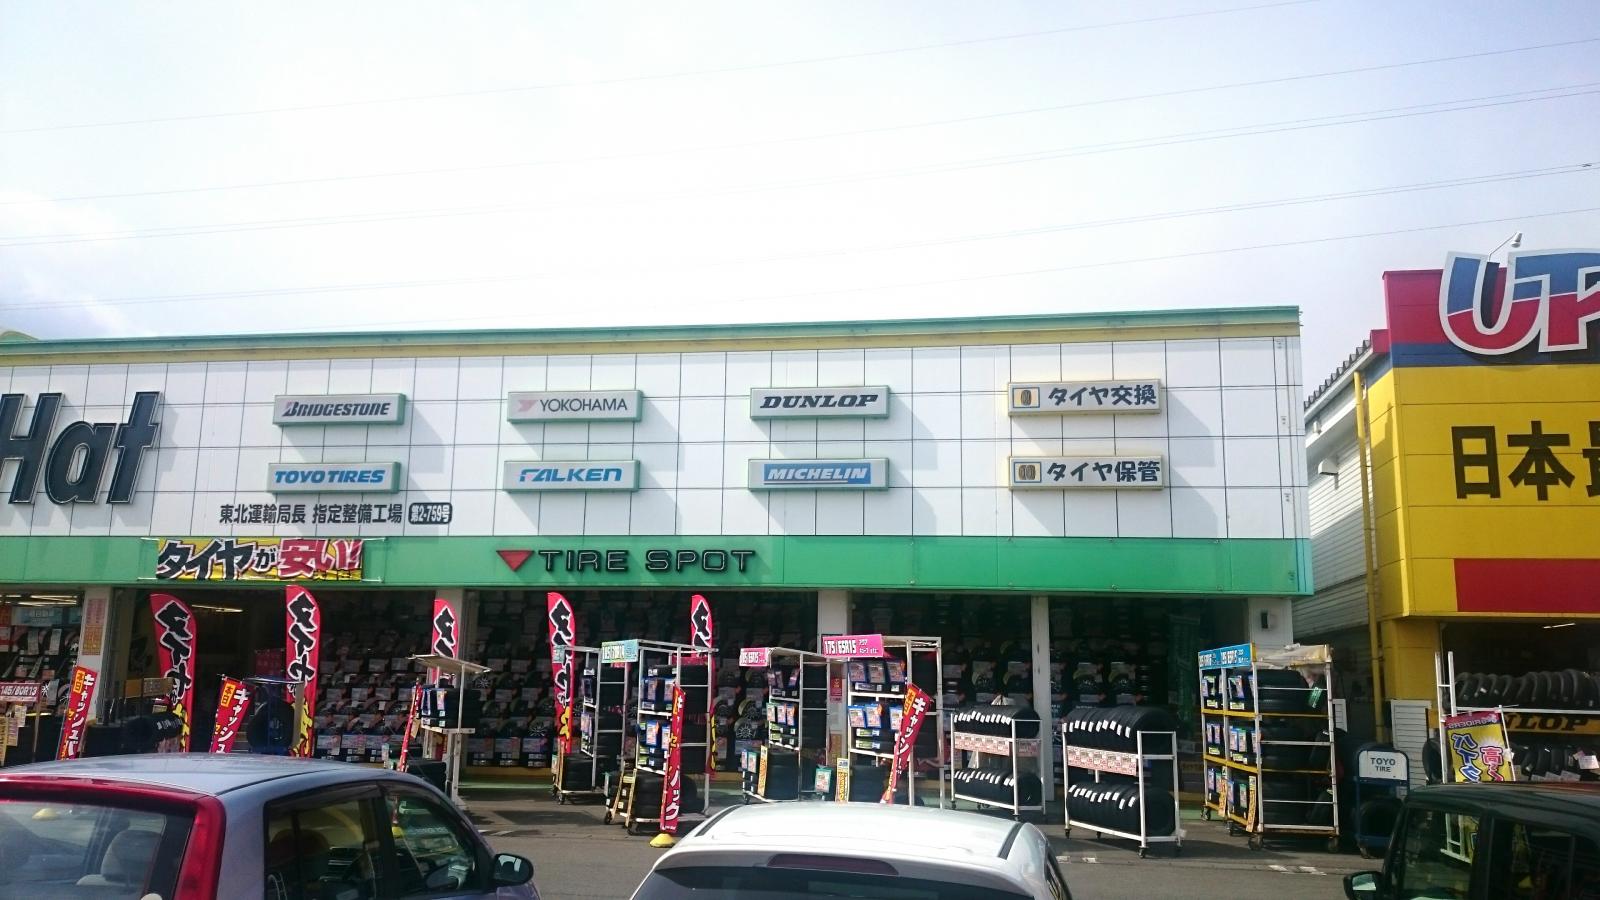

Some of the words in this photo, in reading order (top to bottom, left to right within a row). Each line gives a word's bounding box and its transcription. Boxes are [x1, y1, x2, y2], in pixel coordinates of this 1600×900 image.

[759, 394, 879, 409] DUNLOP
[1048, 384, 1157, 406] タイヤ交換
[281, 400, 391, 418] BRIDGESTONE
[540, 398, 628, 413] YOKOHAMA
[0, 391, 162, 504] Hat
[1451, 420, 1600, 501] 日本
[274, 470, 325, 483] TOYO
[326, 469, 386, 483] TIRES
[519, 468, 623, 483] FALKEN
[767, 467, 868, 481] MICHELIN
[1047, 460, 1160, 482] タイヤ保管
[219, 504, 306, 524] 東北運輸局長
[312, 503, 403, 524] 指定整備工場
[538, 549, 629, 572] TIRE
[645, 549, 757, 572] SPOT
[1370, 757, 1396, 765] TOYO
